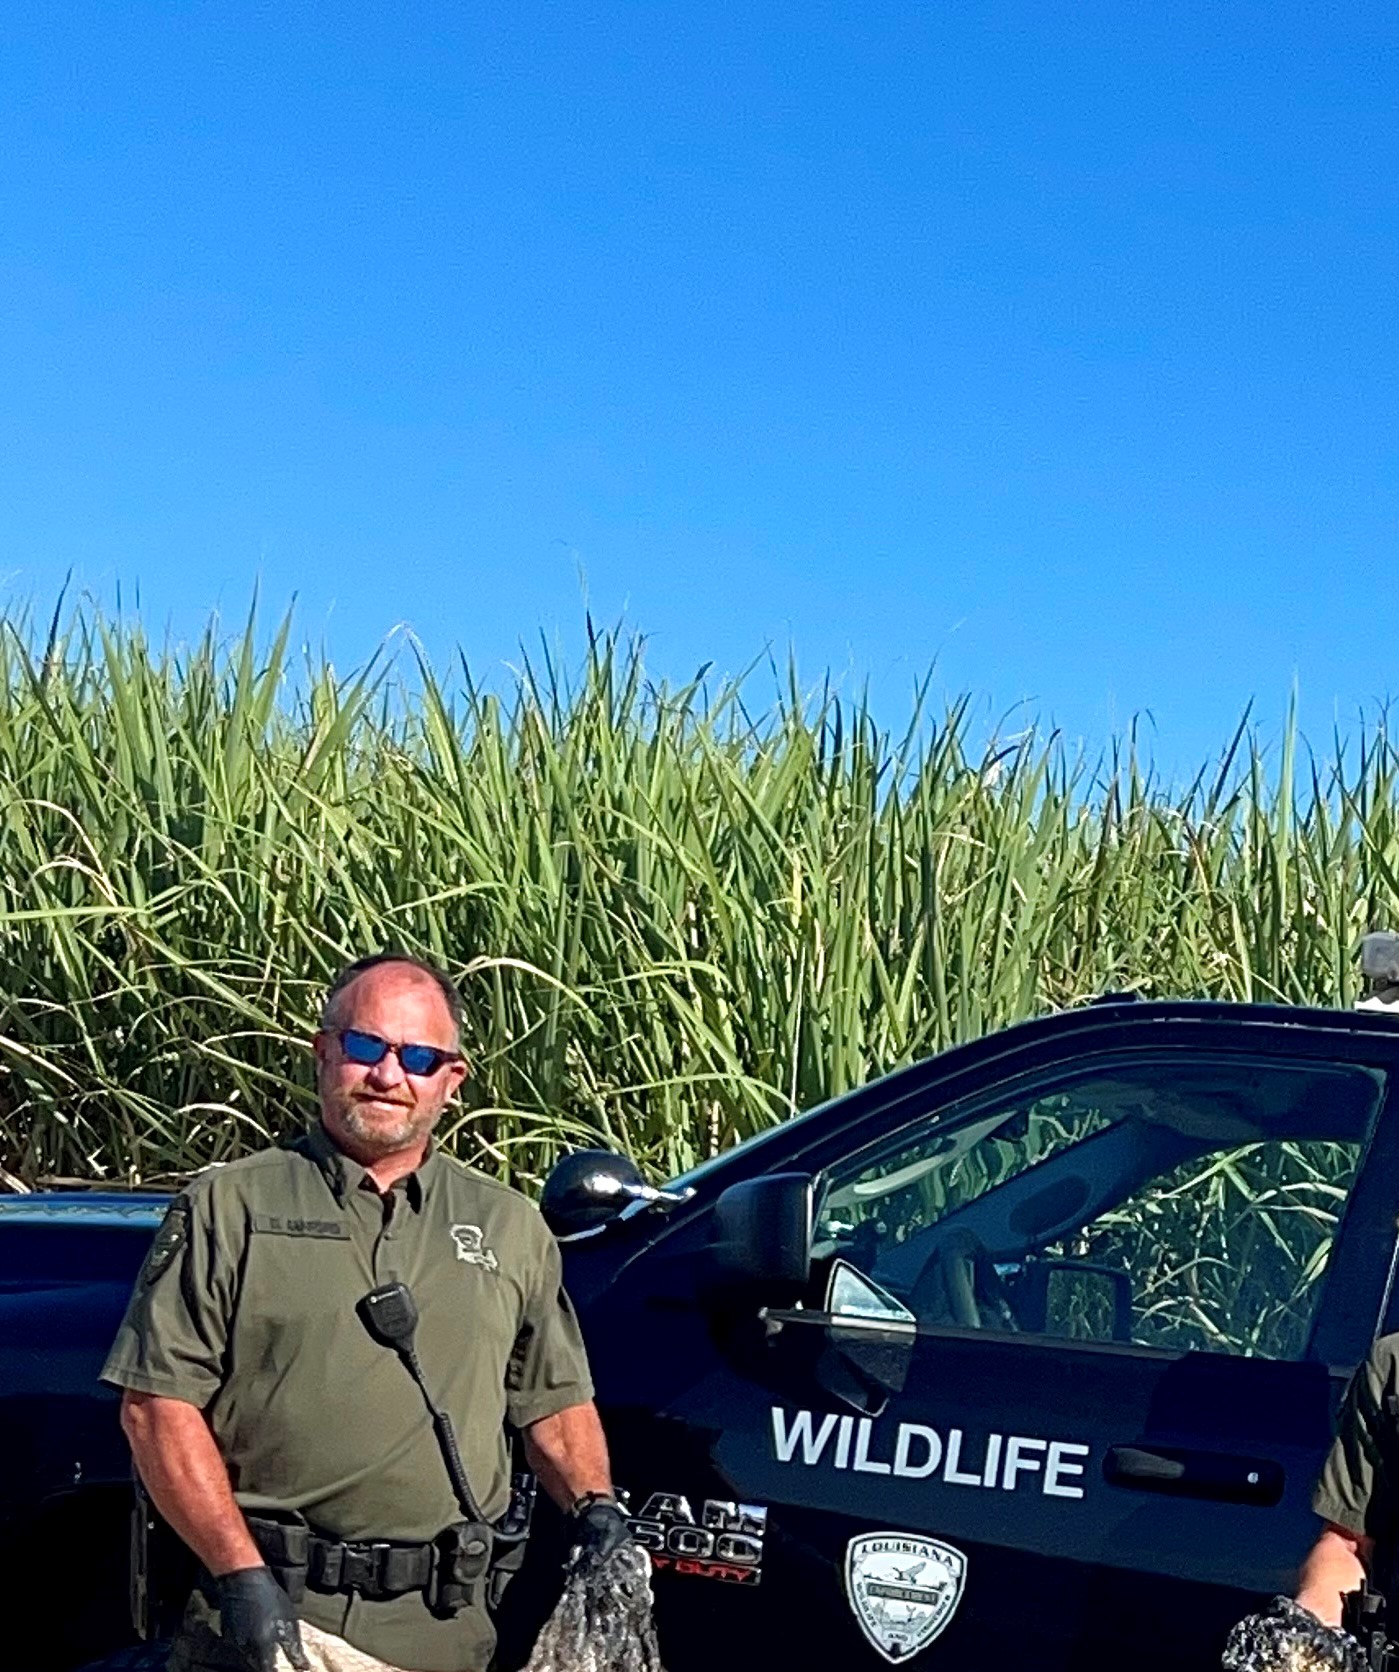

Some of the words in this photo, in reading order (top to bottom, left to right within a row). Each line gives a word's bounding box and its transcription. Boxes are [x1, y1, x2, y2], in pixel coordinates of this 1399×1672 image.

[771, 1406, 1090, 1499] WILDLIFE
[624, 1518, 763, 1565] 500
[861, 1541, 954, 1568] LOUISIANA
